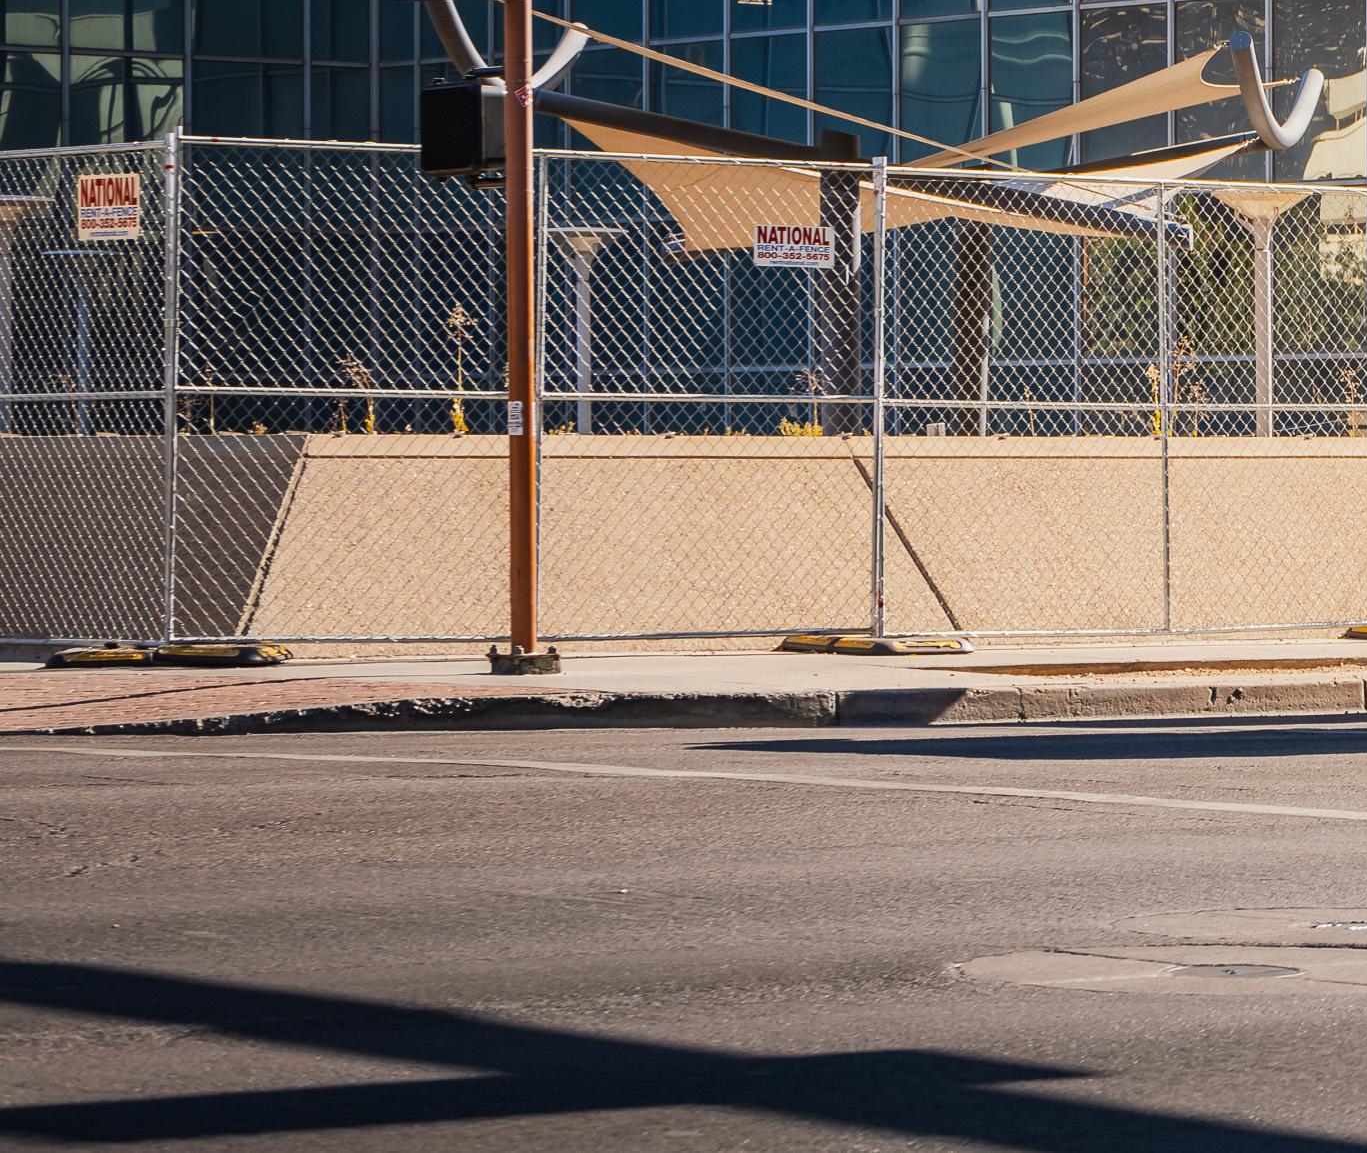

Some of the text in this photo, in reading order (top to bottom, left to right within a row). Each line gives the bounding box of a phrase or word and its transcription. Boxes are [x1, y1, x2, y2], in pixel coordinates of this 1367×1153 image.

[80, 177, 138, 208] NATIONAL
[757, 226, 830, 246] NATIONAL
[757, 245, 830, 253] RENT-A-FENCE
[757, 252, 830, 260] 800-352-5675
